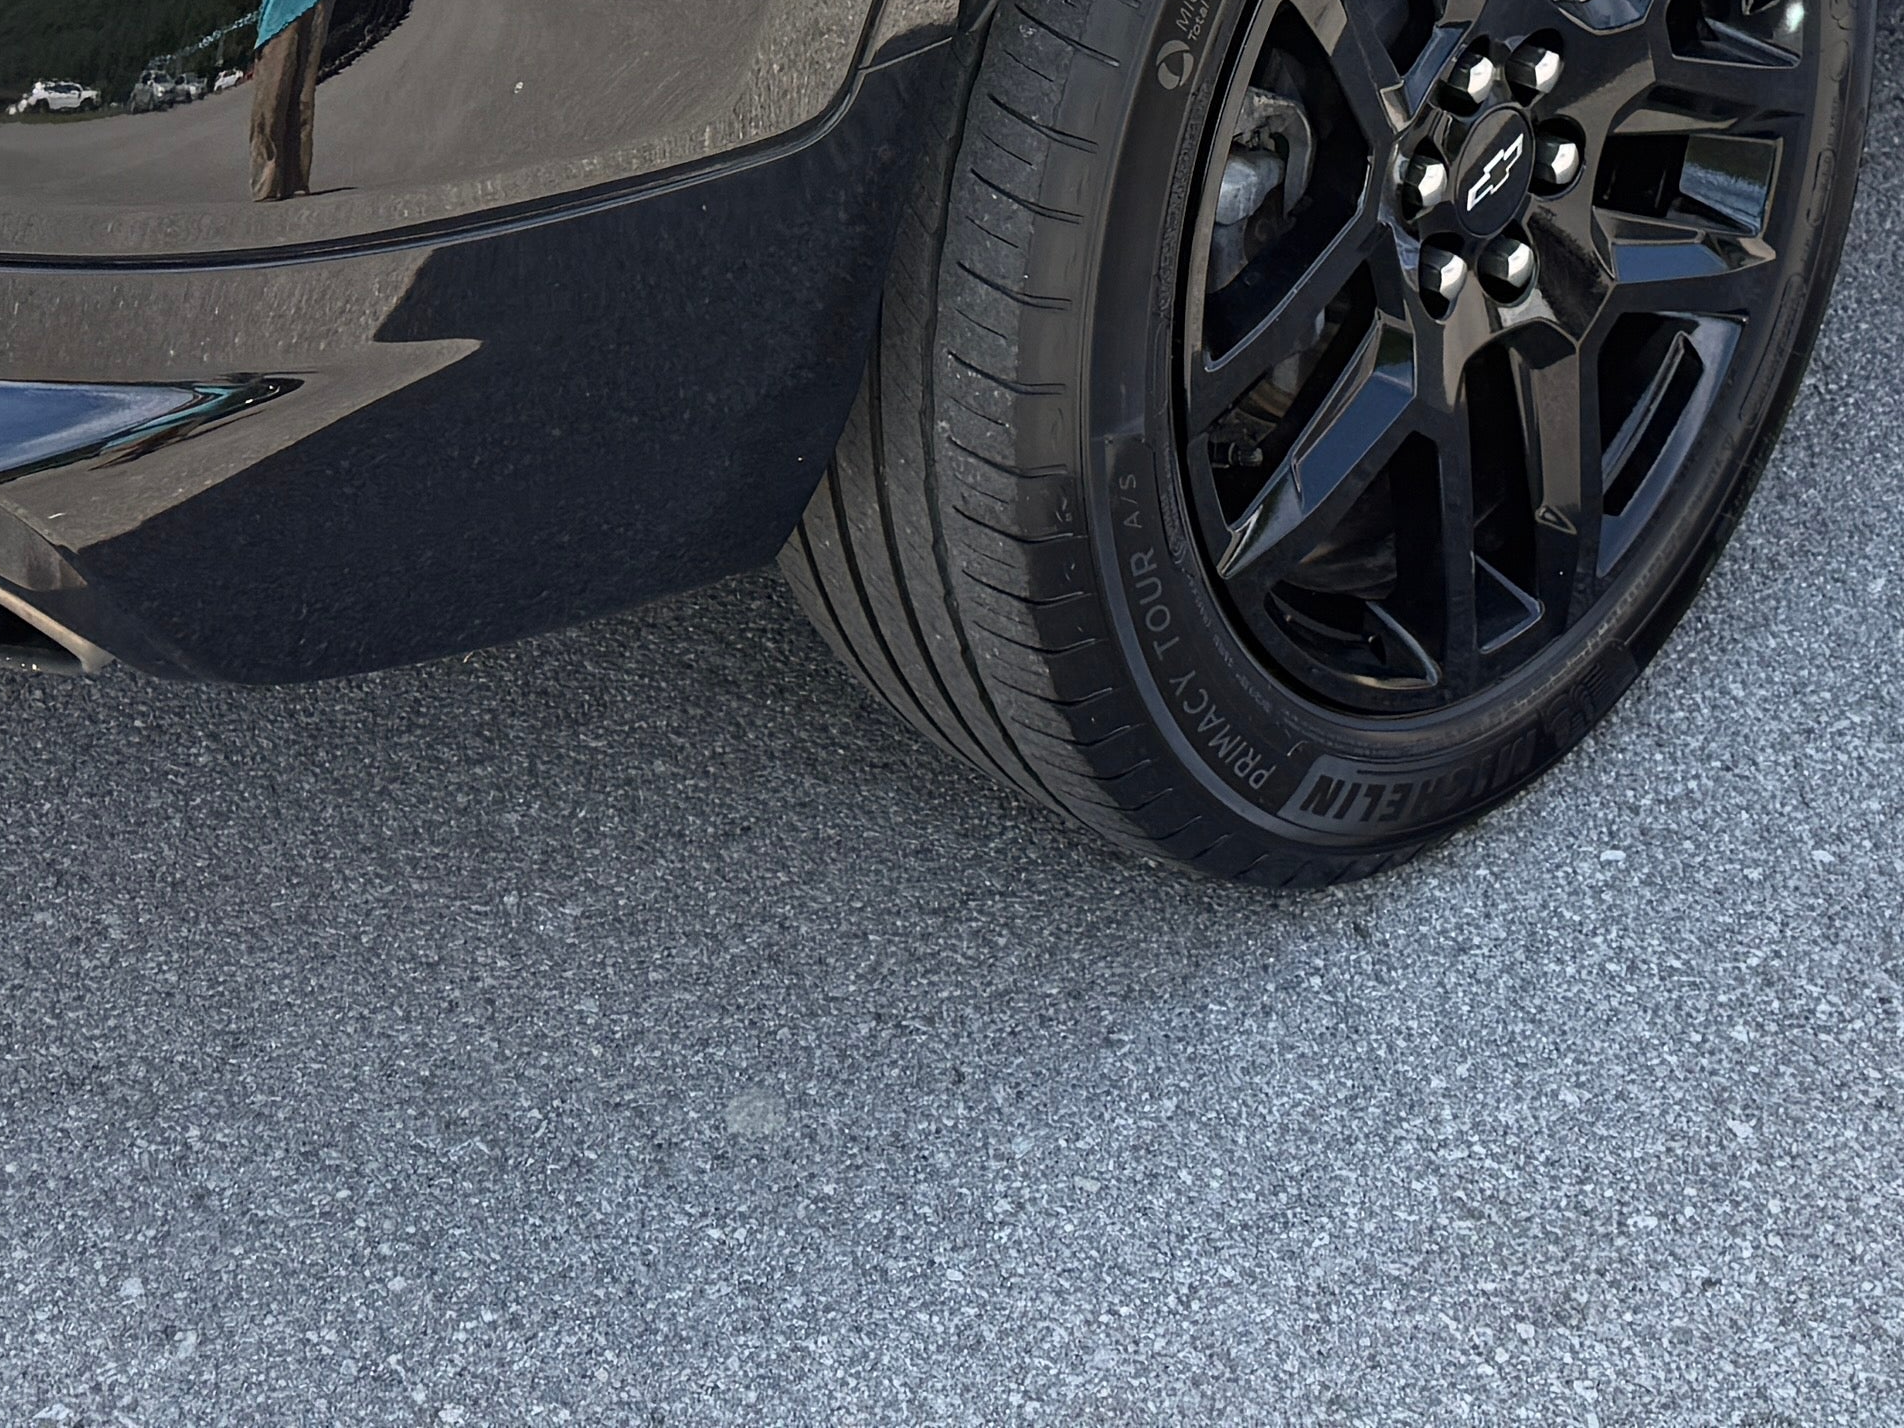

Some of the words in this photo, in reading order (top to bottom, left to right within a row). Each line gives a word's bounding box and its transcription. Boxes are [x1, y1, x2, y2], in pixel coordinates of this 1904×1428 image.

[1188, 0, 1210, 41] Total
[1119, 473, 1143, 529] A/S
[1131, 547, 1179, 661] TOUR
[1169, 670, 1276, 790] PRIMACY
[1300, 732, 1539, 823] MICHELIN
